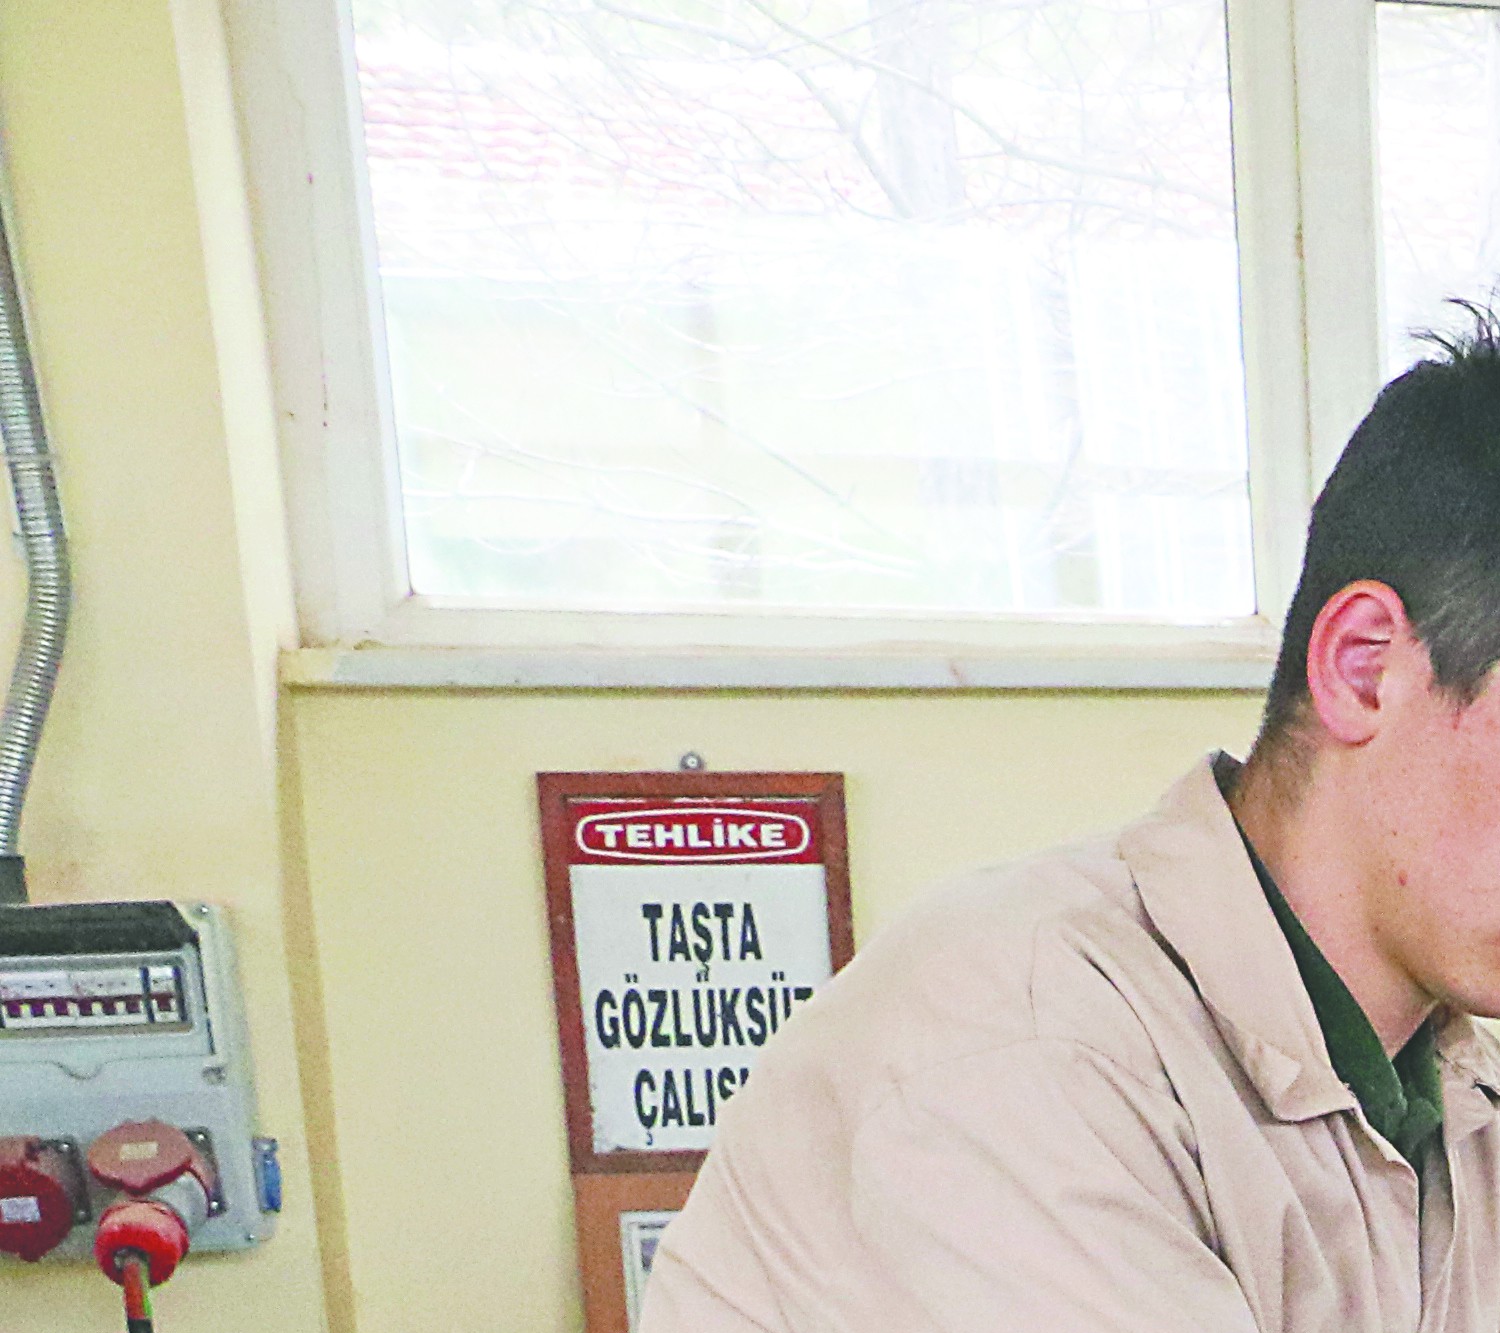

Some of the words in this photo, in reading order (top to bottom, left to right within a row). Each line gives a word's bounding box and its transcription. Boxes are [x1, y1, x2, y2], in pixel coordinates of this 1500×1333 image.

[595, 817, 787, 849] TEHLİKE
[642, 902, 763, 974] TAŞTA
[634, 1066, 750, 1146] ÇALI
